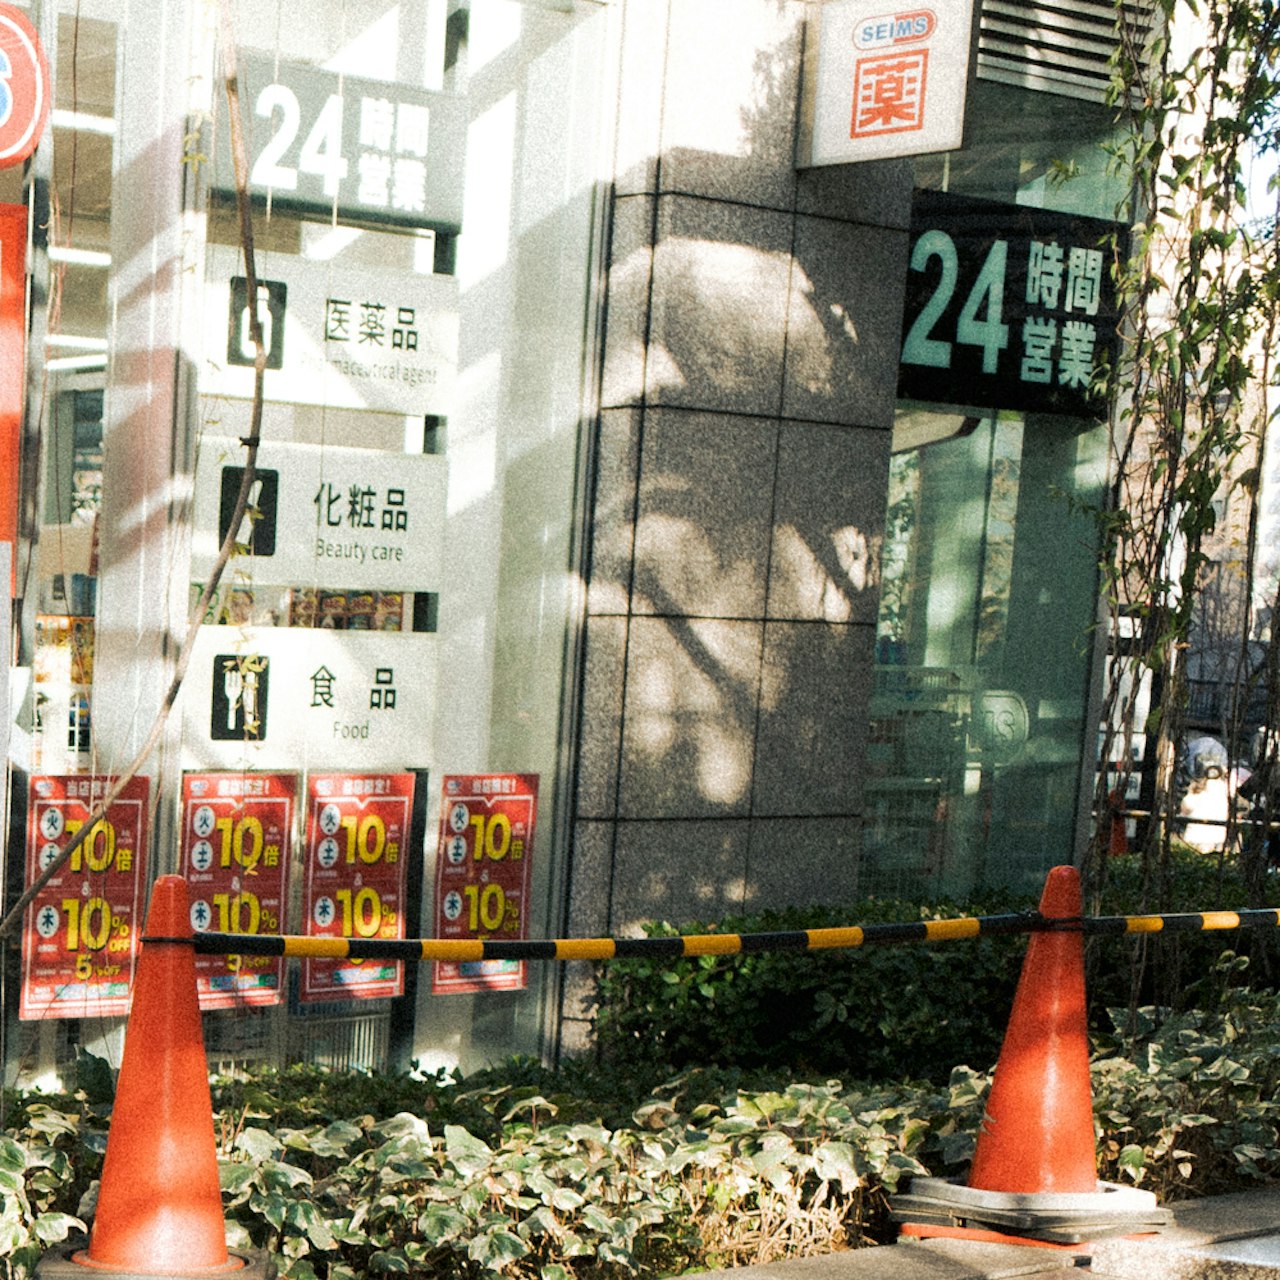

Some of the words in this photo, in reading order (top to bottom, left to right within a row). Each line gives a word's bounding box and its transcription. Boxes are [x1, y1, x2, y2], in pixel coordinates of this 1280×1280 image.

[860, 18, 929, 44] SEIMS
[857, 60, 920, 127] 薬
[251, 84, 348, 198] 24
[359, 97, 430, 158] 時間
[358, 153, 428, 212] 営業
[324, 298, 418, 351] 医薬品
[901, 230, 1010, 376] 24
[1025, 240, 1104, 316] 時間
[1020, 317, 1097, 389] 営業
[313, 484, 409, 533] 化粧品
[316, 538, 367, 566] Beauty
[371, 543, 403, 563] care
[309, 664, 397, 711] 食品
[333, 721, 370, 741] Food
